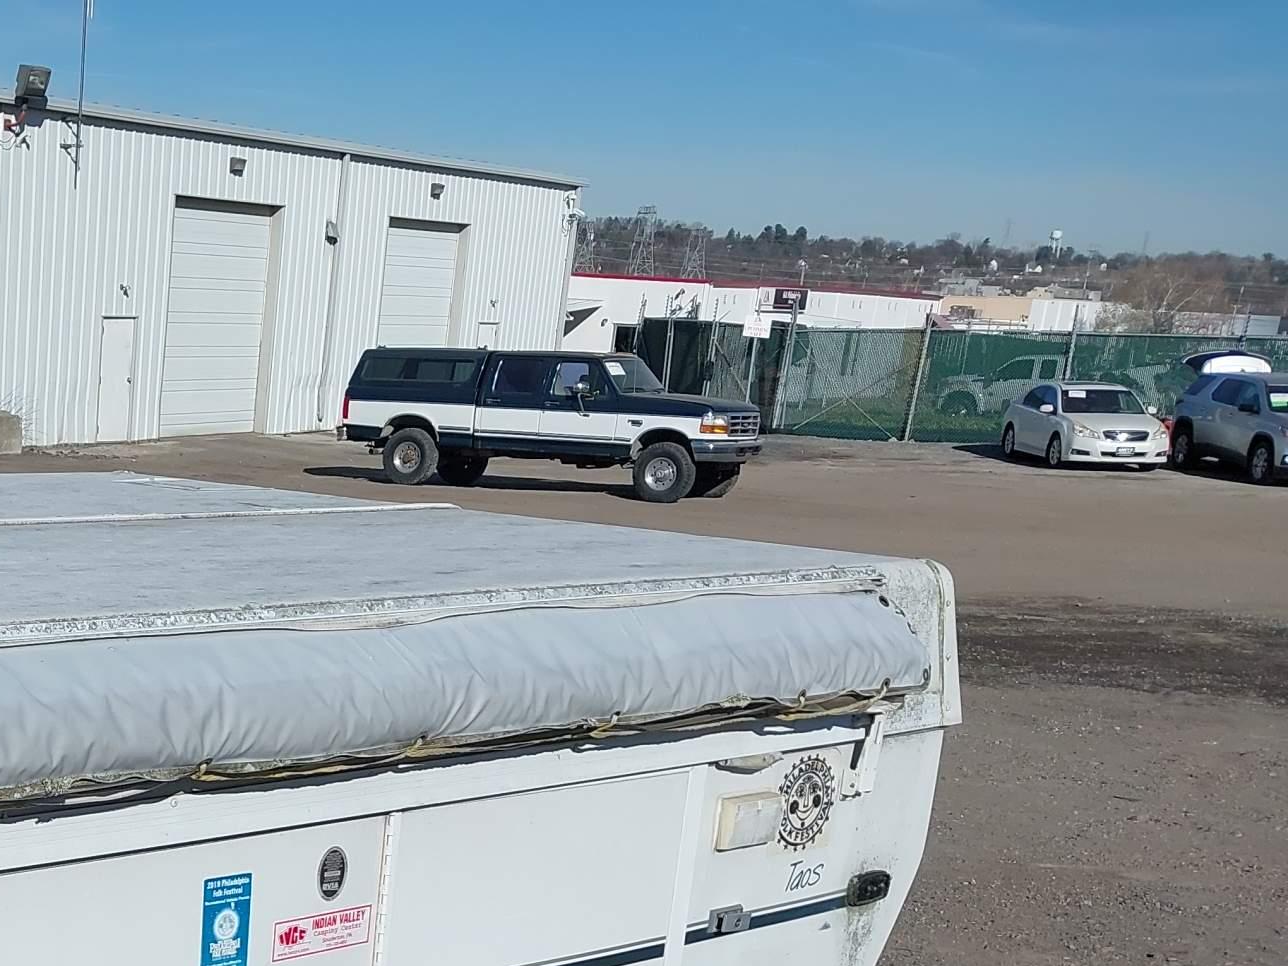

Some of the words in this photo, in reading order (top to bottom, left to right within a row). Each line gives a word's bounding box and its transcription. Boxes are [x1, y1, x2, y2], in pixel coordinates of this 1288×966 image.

[784, 860, 824, 892] Taos
[312, 914, 338, 930] INDIAN
[339, 910, 366, 925] VALLEY
